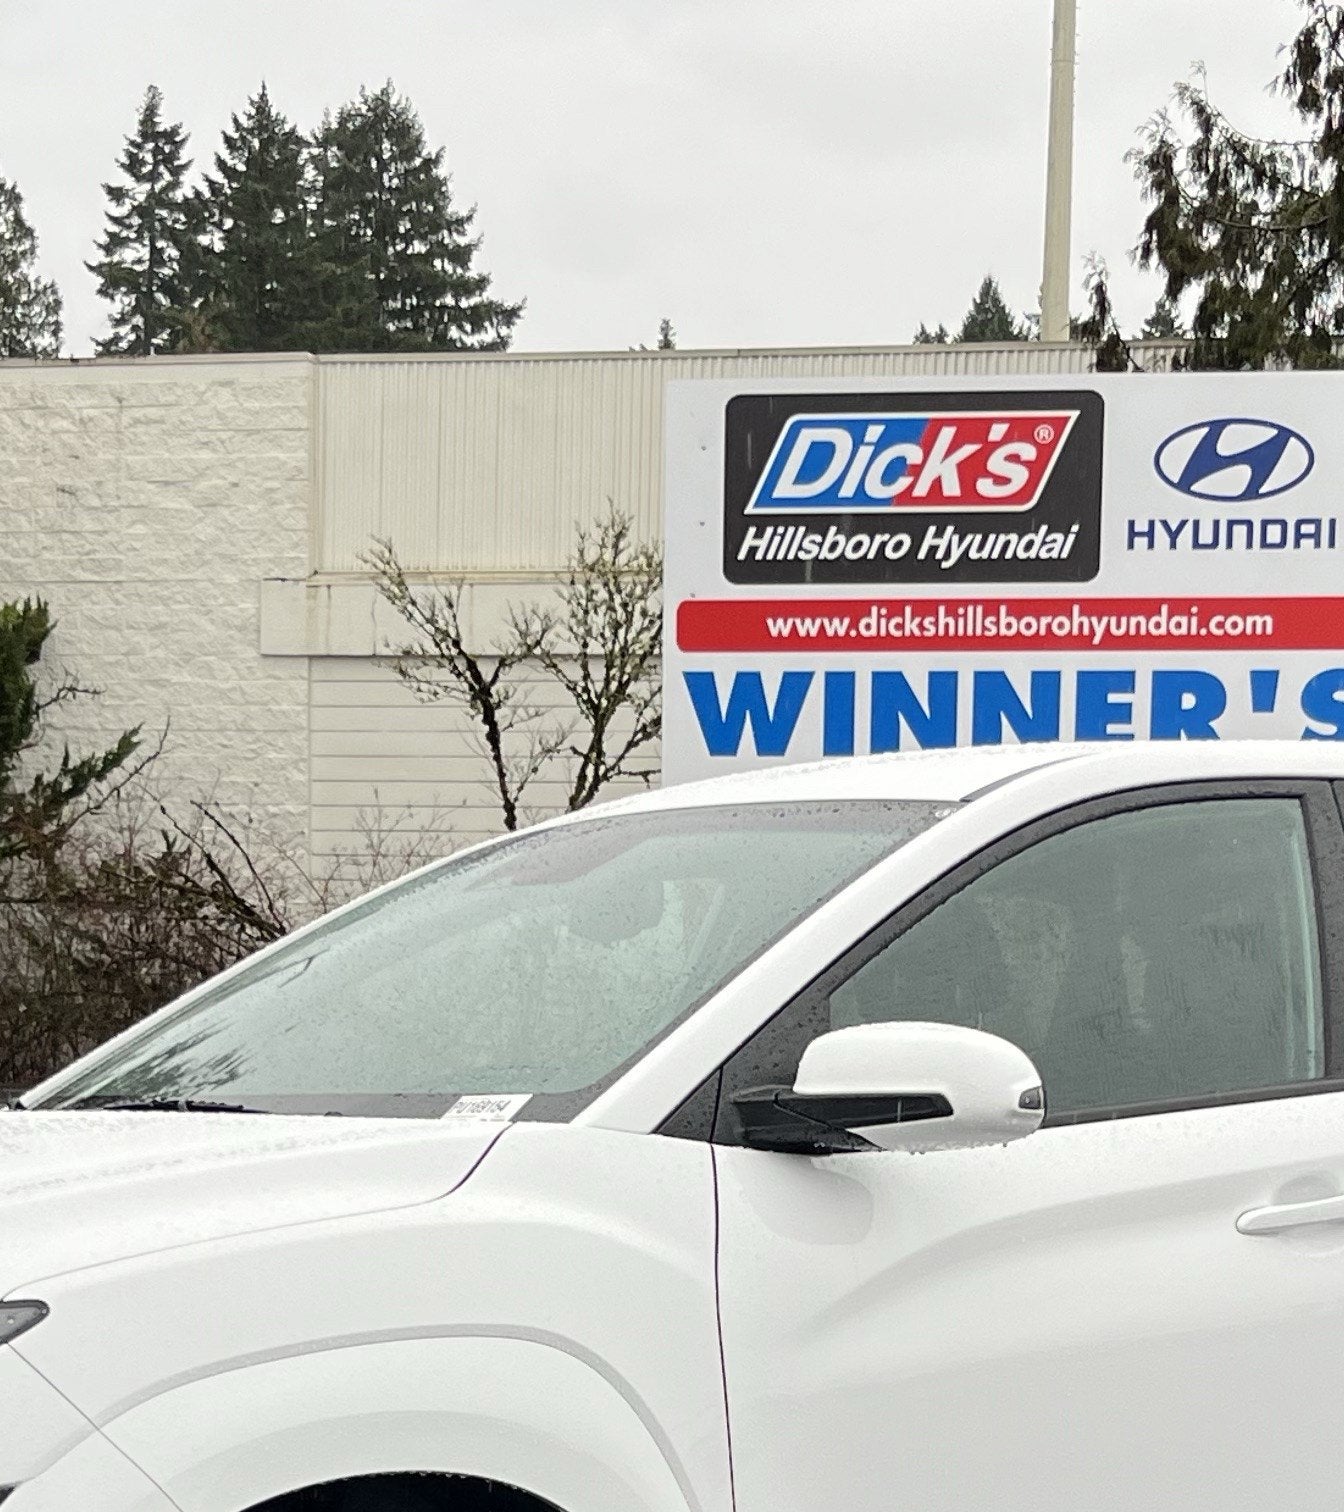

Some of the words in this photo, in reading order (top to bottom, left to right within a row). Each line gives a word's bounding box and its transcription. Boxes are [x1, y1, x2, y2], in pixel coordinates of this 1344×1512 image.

[771, 423, 1037, 500] Dick's
[737, 526, 912, 562] Hillsboro
[917, 524, 1081, 570] Hyundai
[1126, 518, 1337, 551] HYUNDAI
[765, 604, 1274, 646] www.dickshillsborohyundai.com
